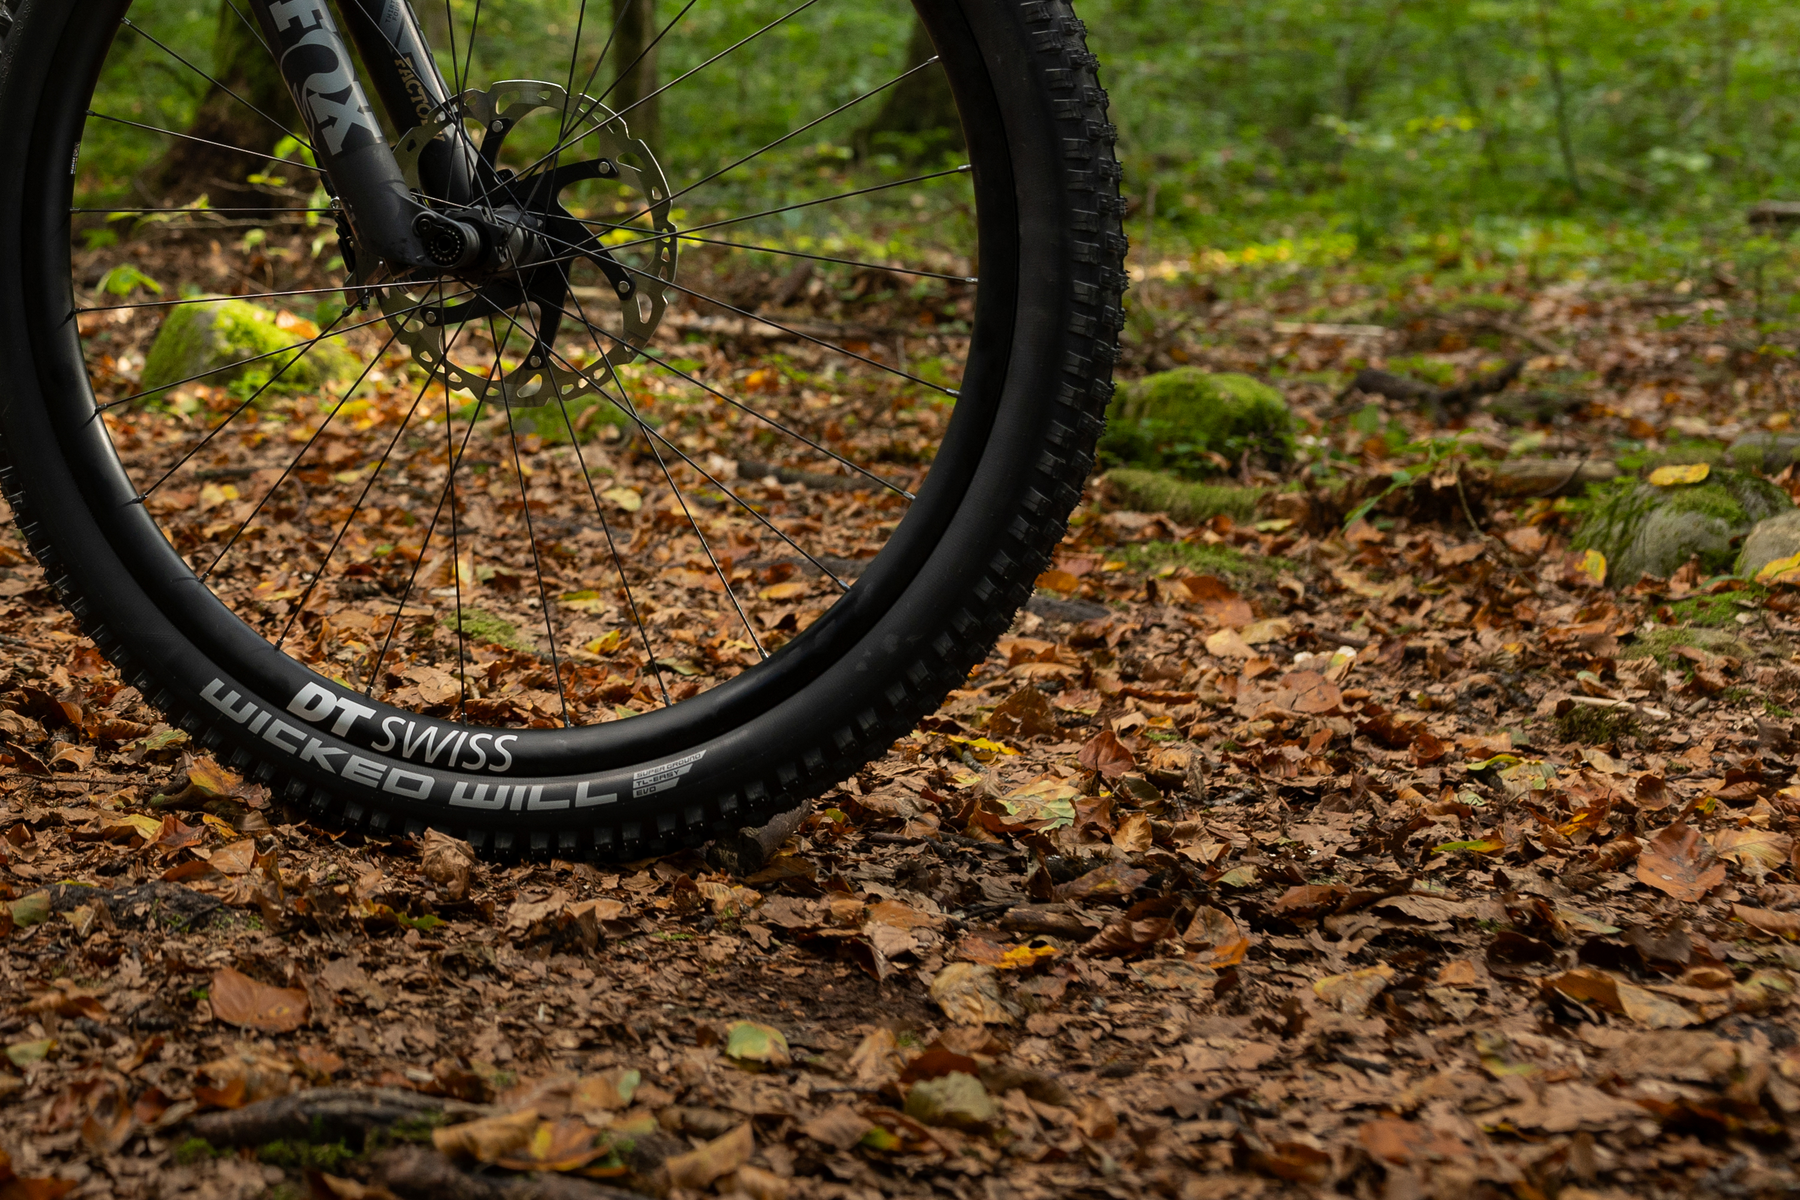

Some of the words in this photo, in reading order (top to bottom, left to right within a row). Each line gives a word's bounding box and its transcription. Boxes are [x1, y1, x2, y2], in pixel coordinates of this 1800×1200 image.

[394, 57, 446, 142] FACTO
[199, 677, 436, 800] WICKED
[448, 780, 618, 811] WILL
[286, 680, 378, 738] DT
[371, 716, 518, 772] SWISS
[636, 770, 680, 787] TL-EASY
[636, 786, 657, 796] EVO
[637, 766, 665, 778] SUPER
